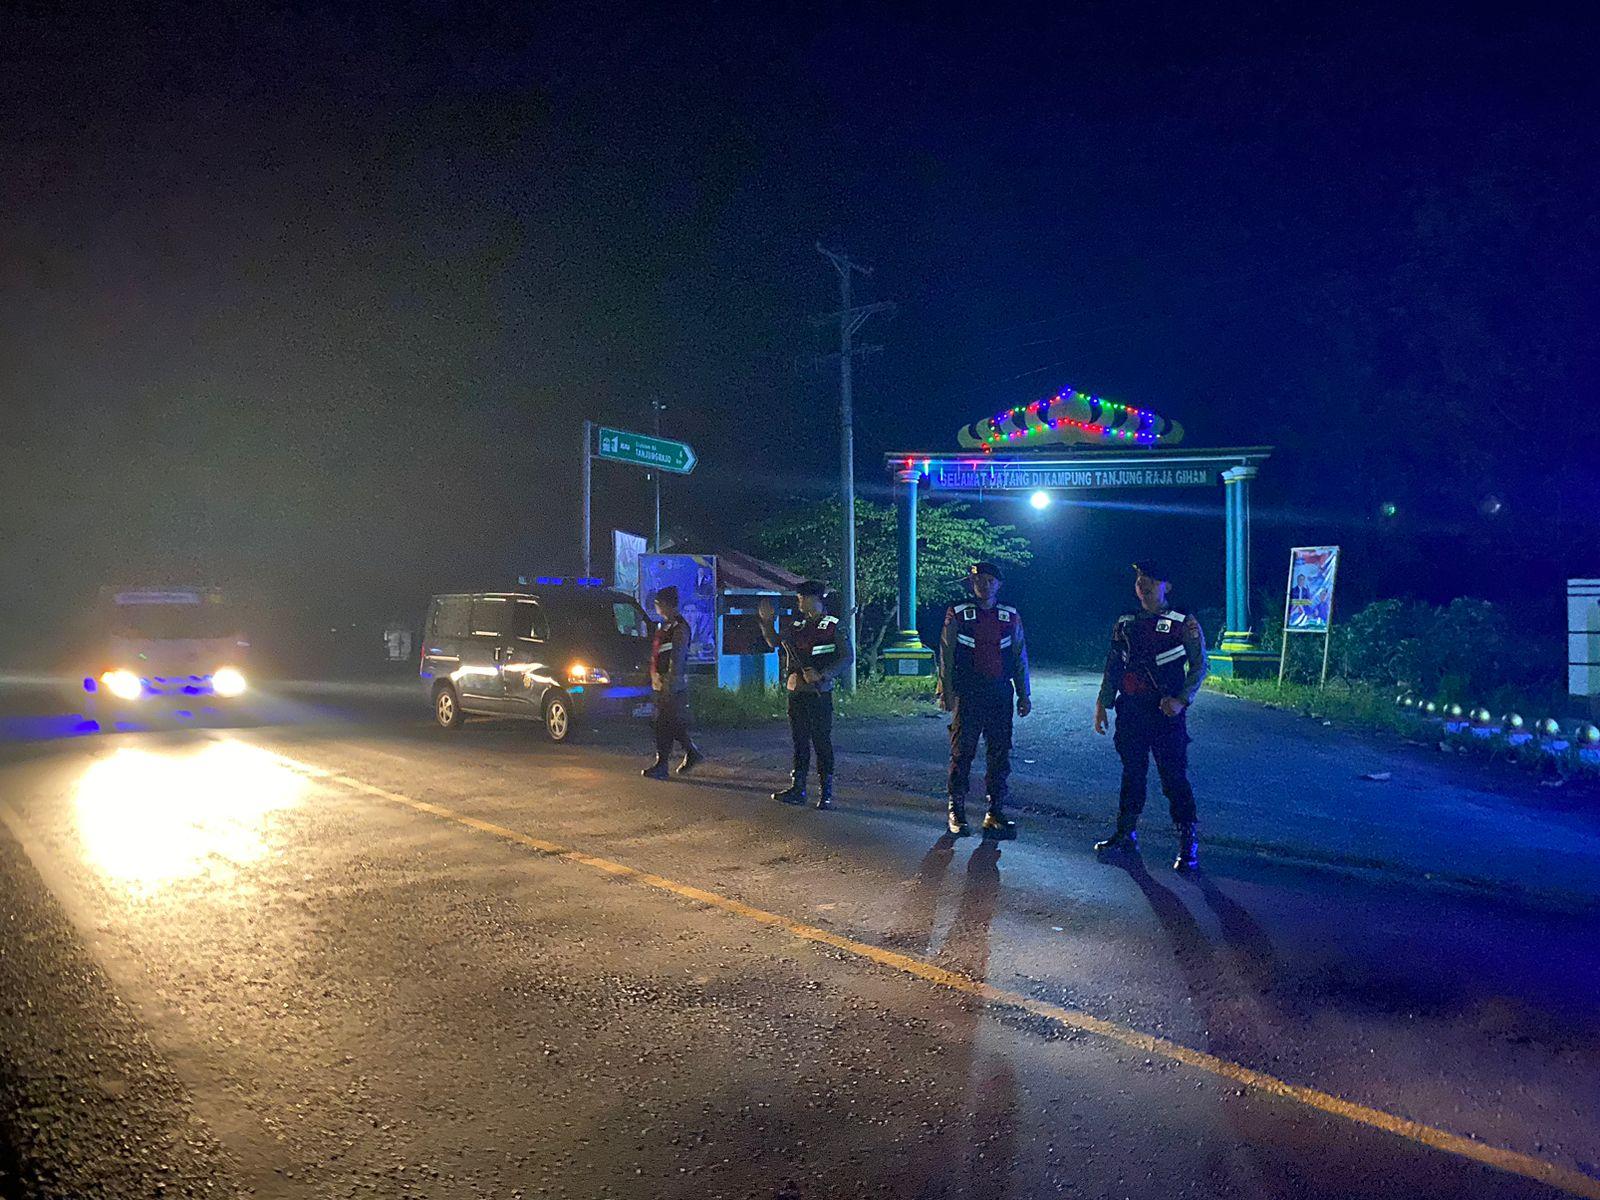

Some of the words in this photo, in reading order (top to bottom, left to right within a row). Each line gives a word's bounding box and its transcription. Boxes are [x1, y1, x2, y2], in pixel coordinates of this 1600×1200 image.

[941, 472, 986, 487] SELAMAT
[990, 472, 1030, 486] DATANG
[1033, 472, 1042, 486] DI
[1044, 471, 1092, 486] KAMPUNG
[1095, 471, 1143, 486] TANJUNG
[1145, 470, 1173, 485] RAJA
